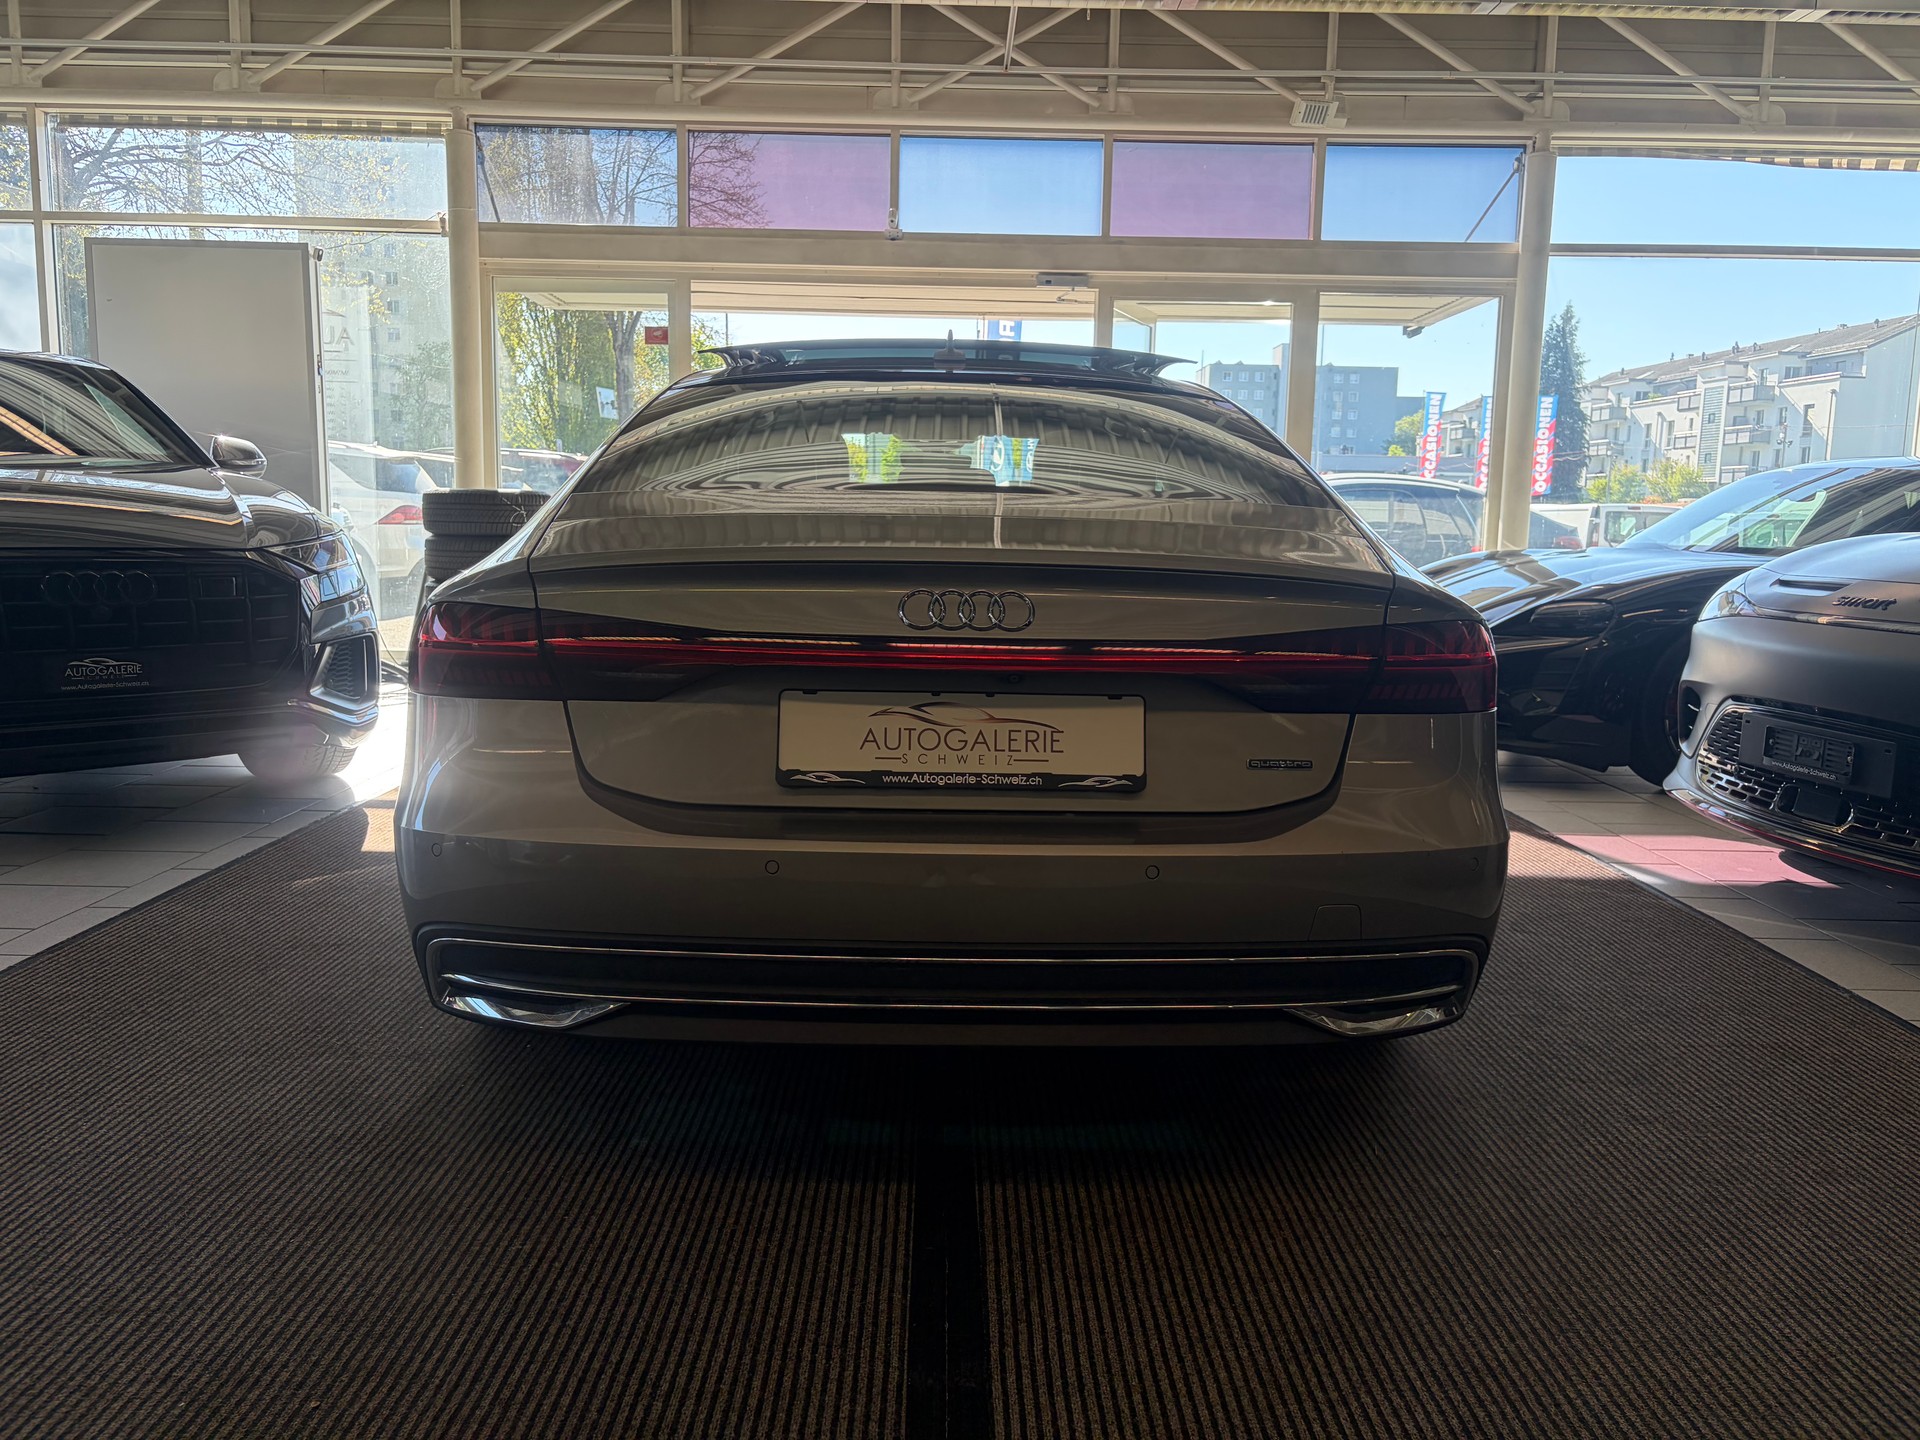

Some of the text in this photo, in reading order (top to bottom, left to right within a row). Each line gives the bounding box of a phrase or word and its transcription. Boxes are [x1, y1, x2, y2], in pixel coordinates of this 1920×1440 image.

[1424, 394, 1442, 478] CCASIONEN
[1534, 397, 1553, 492] OCCASIONEN
[1832, 596, 1897, 611] smart
[64, 664, 143, 677] AUTOGALERIE
[859, 727, 1064, 753] AUTOGALERIE
[901, 753, 1014, 766] SCHWEIZ
[1250, 760, 1312, 768] quattro
[882, 772, 1043, 786] www.Autogalerie-Schweiz.ch
